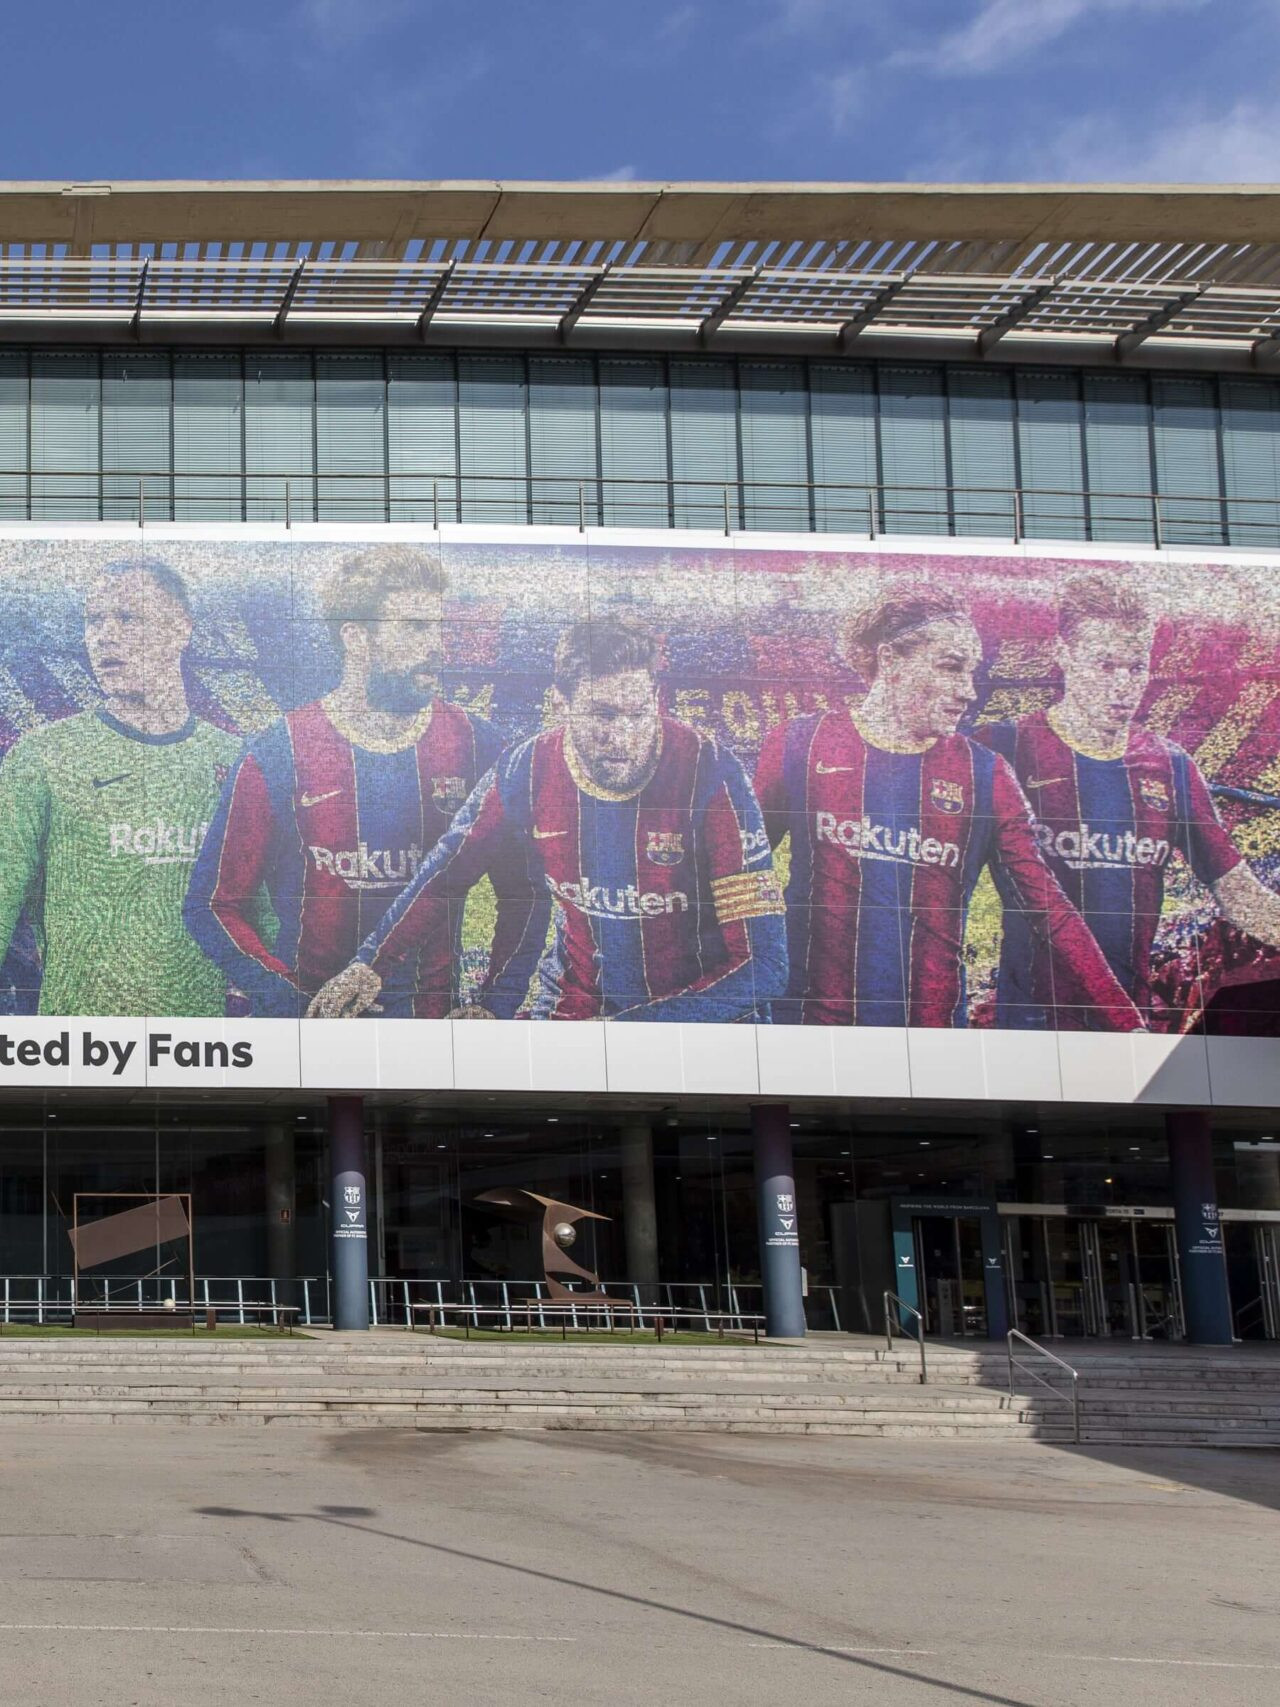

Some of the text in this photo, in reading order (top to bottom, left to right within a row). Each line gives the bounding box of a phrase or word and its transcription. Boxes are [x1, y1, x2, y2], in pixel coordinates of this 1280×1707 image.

[815, 811, 961, 868] Rakuten
[83, 1032, 136, 1075] by
[150, 1034, 252, 1067] Fans
